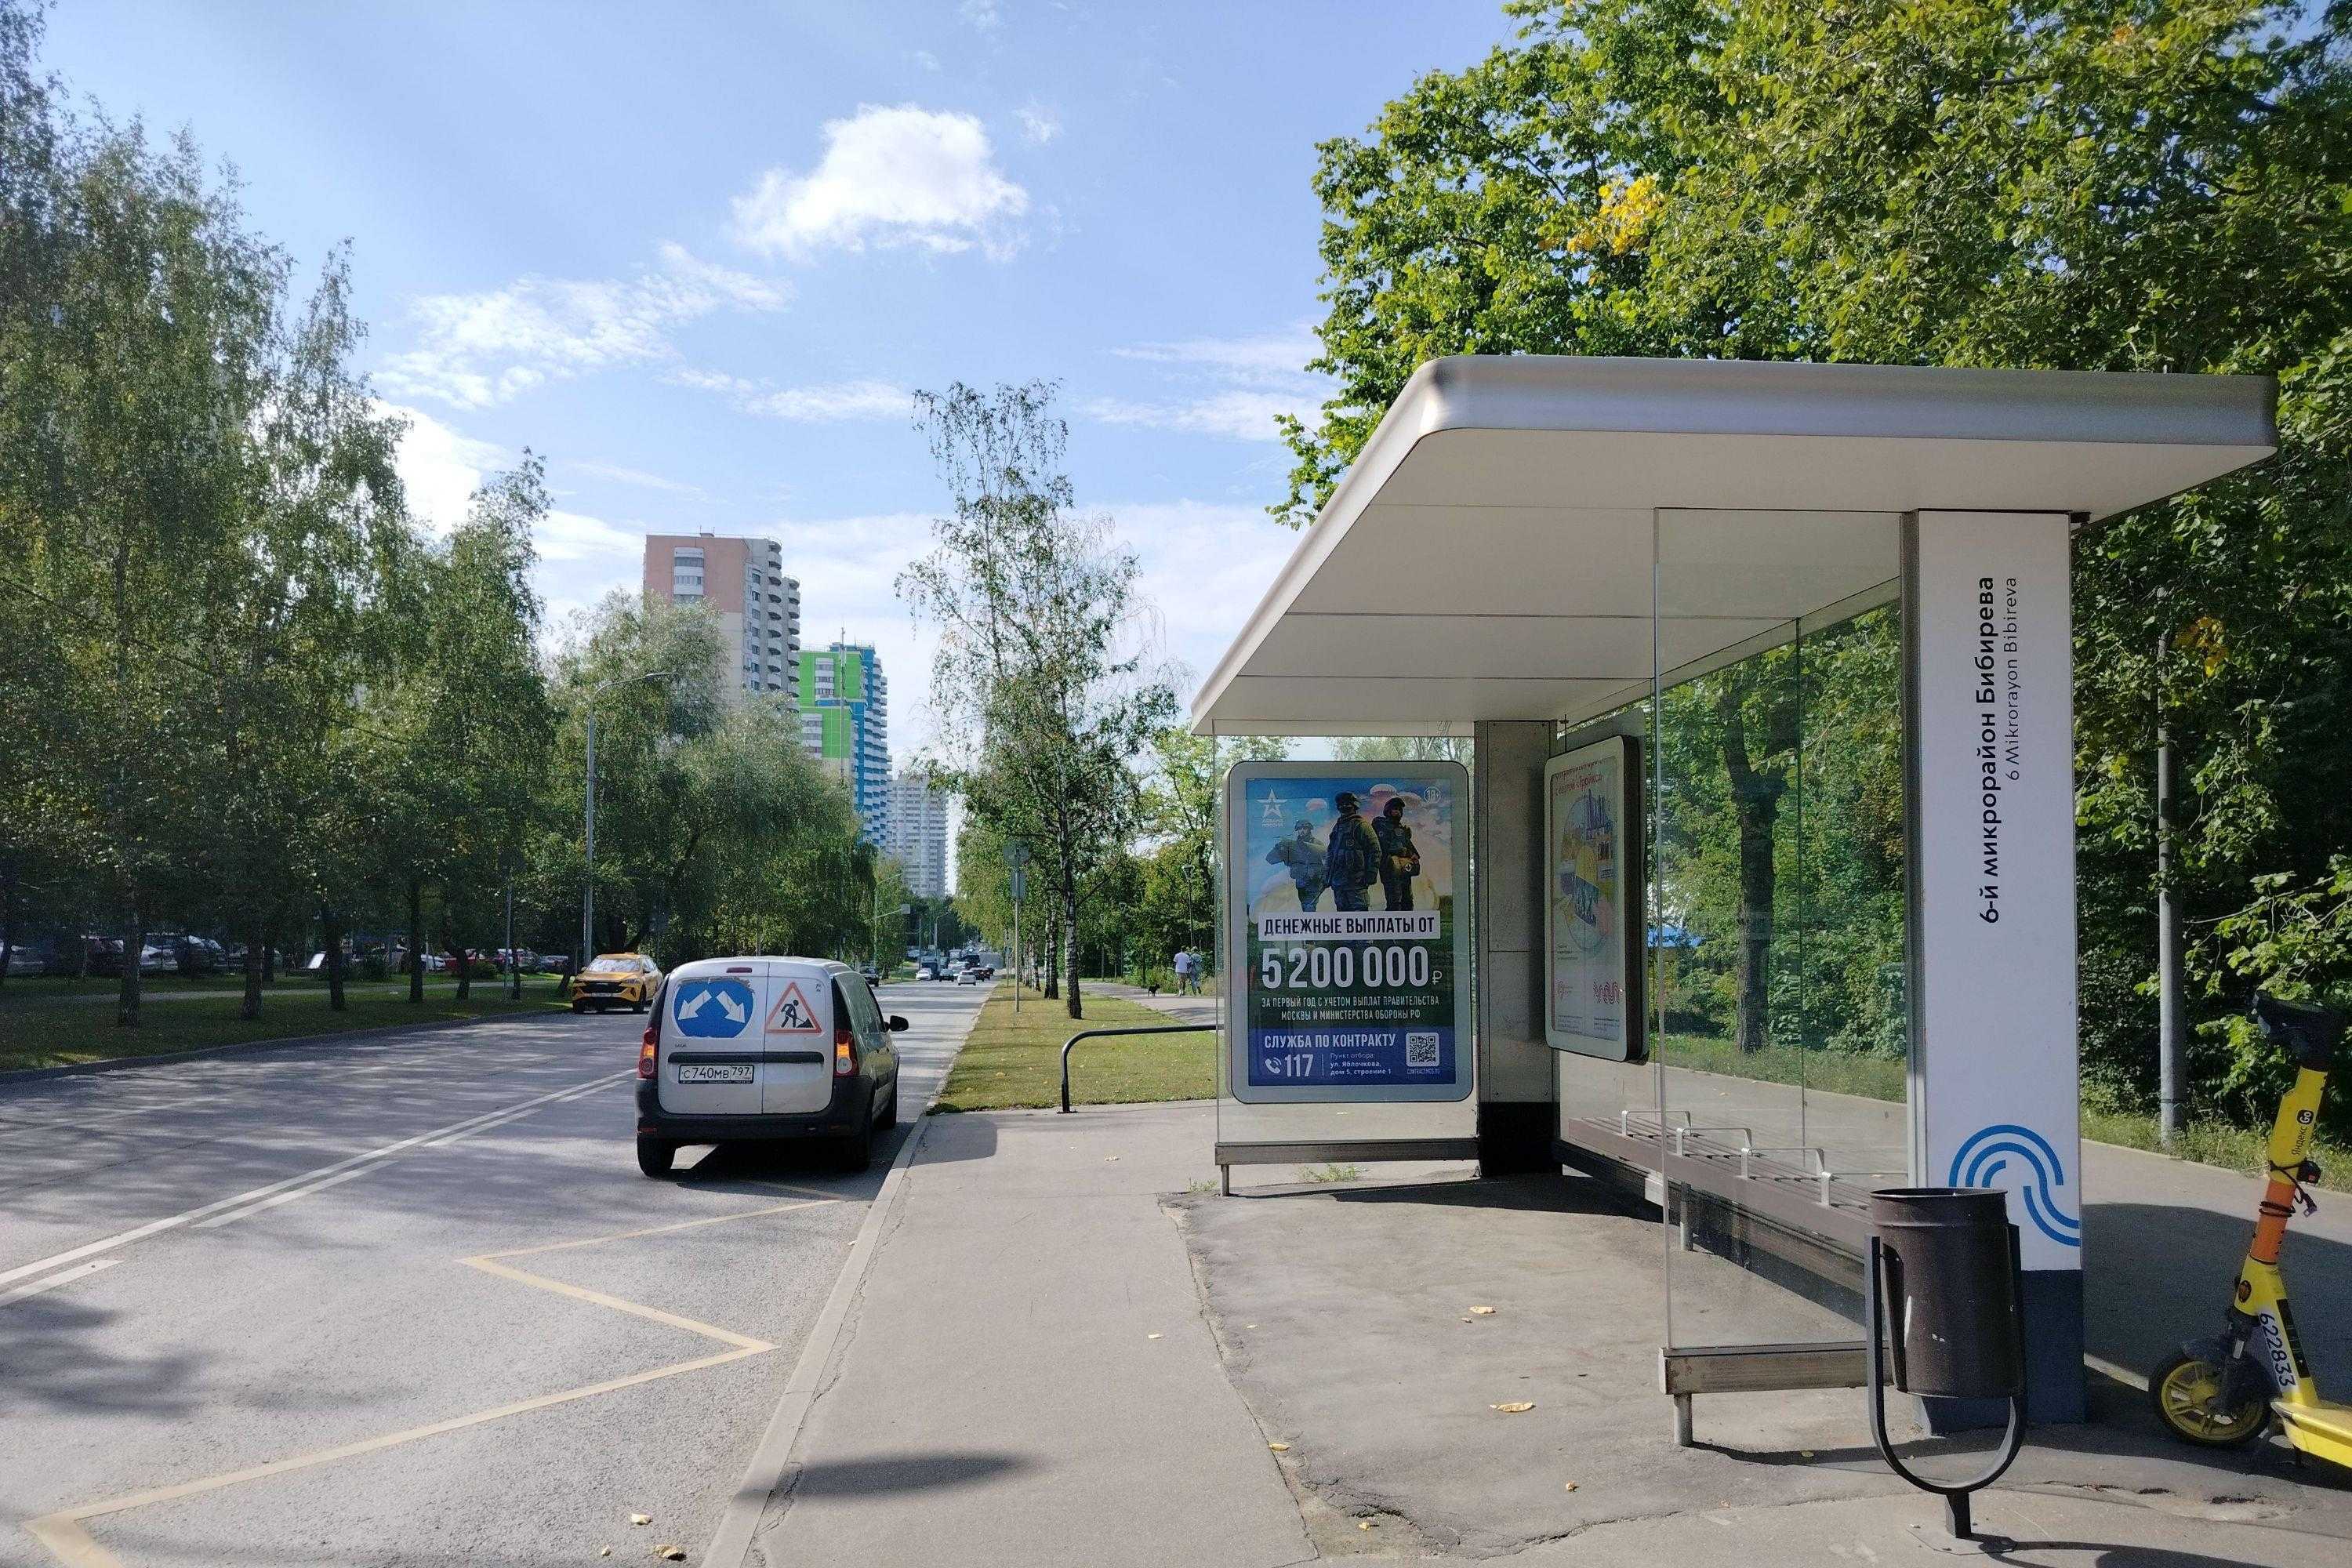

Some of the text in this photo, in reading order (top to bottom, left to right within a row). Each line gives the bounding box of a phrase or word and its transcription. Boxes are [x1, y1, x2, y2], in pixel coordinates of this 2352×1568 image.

[2003, 577, 2021, 781] 6 Mikrorayon Bibireva
[1974, 577, 2002, 924] 6-й микрорайон Бибирева
[1265, 917, 1434, 936] ДЕНЕЖНЫЕ ВЫПЛАТЫ ОТ
[1262, 948, 1282, 989] 5
[1288, 946, 1354, 989] 200
[1363, 946, 1428, 988] 000
[1261, 995, 1439, 1008] ЗА ПЕРВЫЙ ГОД С УЧЕТОМ ВЫПЛАТ ПРАВИТЕЛЬСТВА
[1281, 1009, 1421, 1021] МОСКВЫ И МИНИСТЕРСТВА ОБОРОНЫ РФ
[1265, 1033, 1396, 1048] СЛУЖБА ПО КОНТРАКТУ
[731, 1066, 750, 1076] 797
[1284, 1054, 1314, 1077] 117
[2291, 1111, 2312, 1156] Яндекс Go
[2259, 1312, 2296, 1387] 622833
